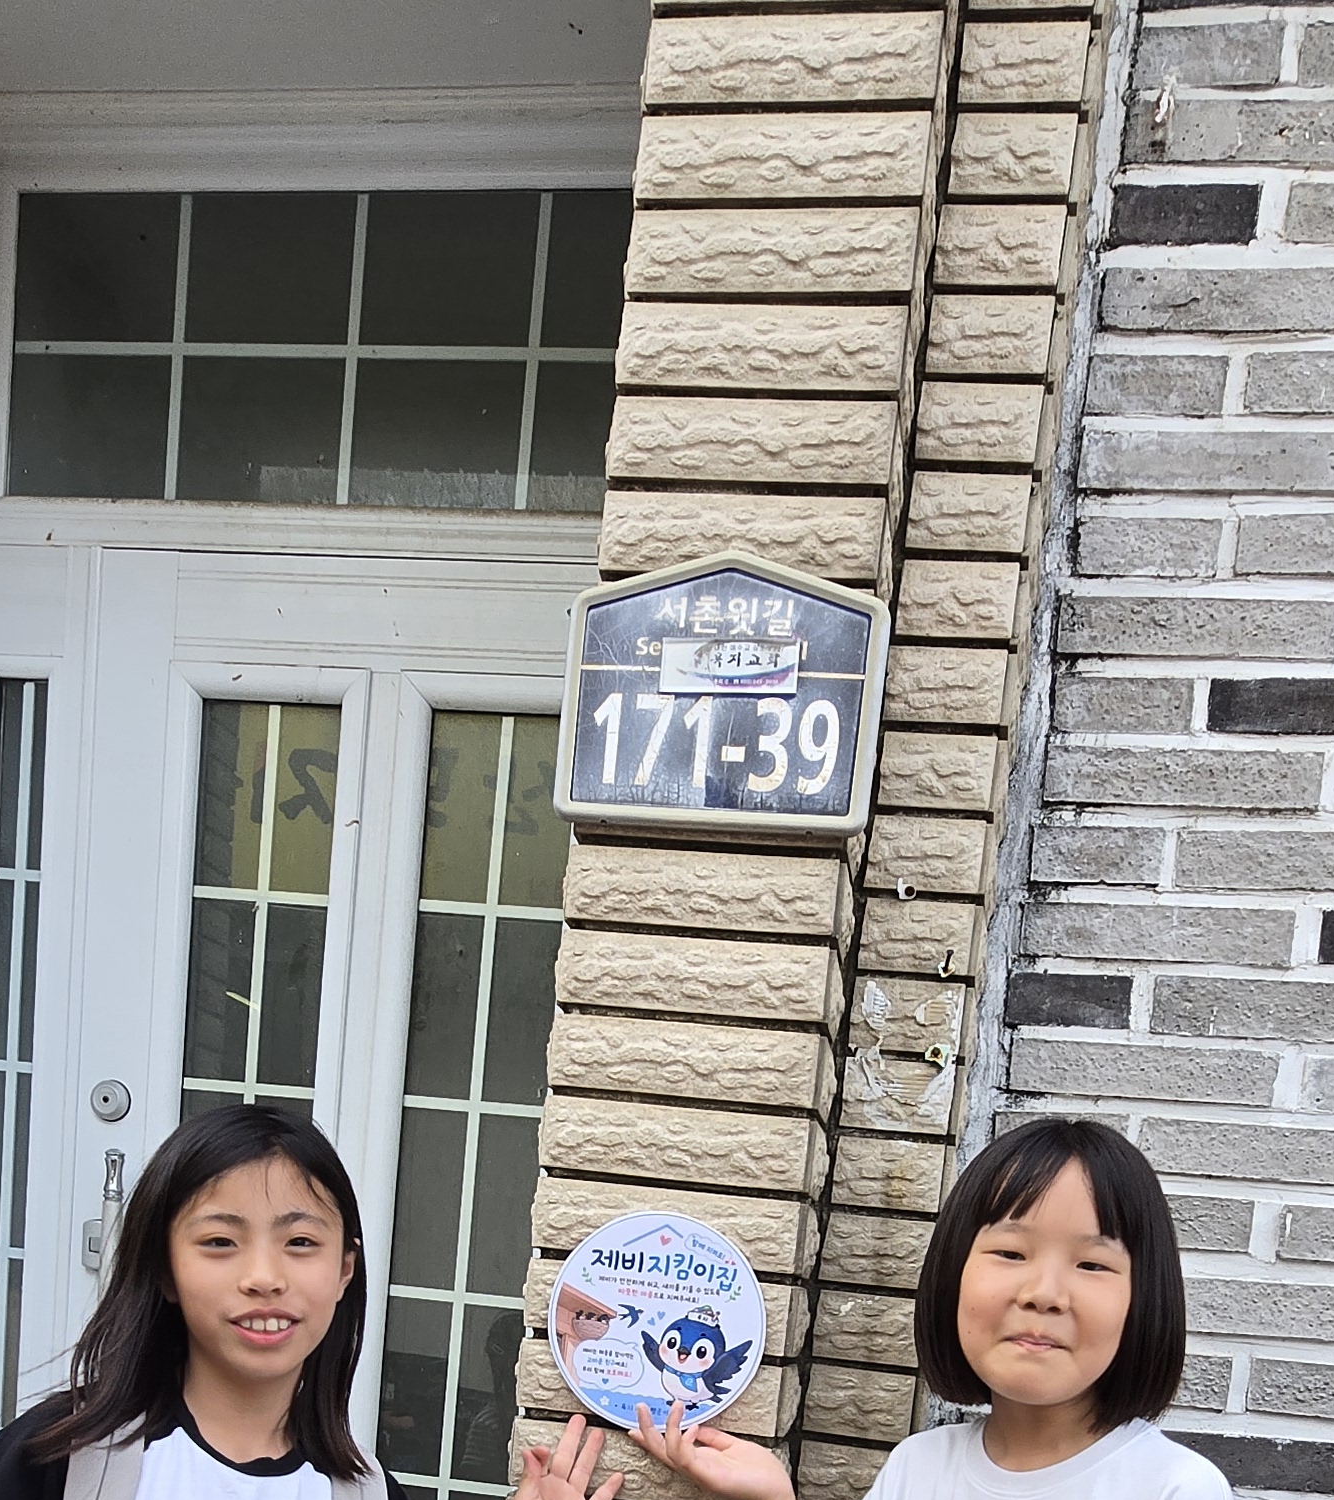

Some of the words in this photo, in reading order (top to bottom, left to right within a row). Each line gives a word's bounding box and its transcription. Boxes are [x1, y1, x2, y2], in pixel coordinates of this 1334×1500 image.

[655, 596, 794, 636] 서촌윗길
[593, 692, 840, 795] 171-39
[590, 1248, 738, 1292] 제비지킴이집
[598, 1275, 618, 1284] 제비가
[619, 1277, 645, 1287] 안전하게
